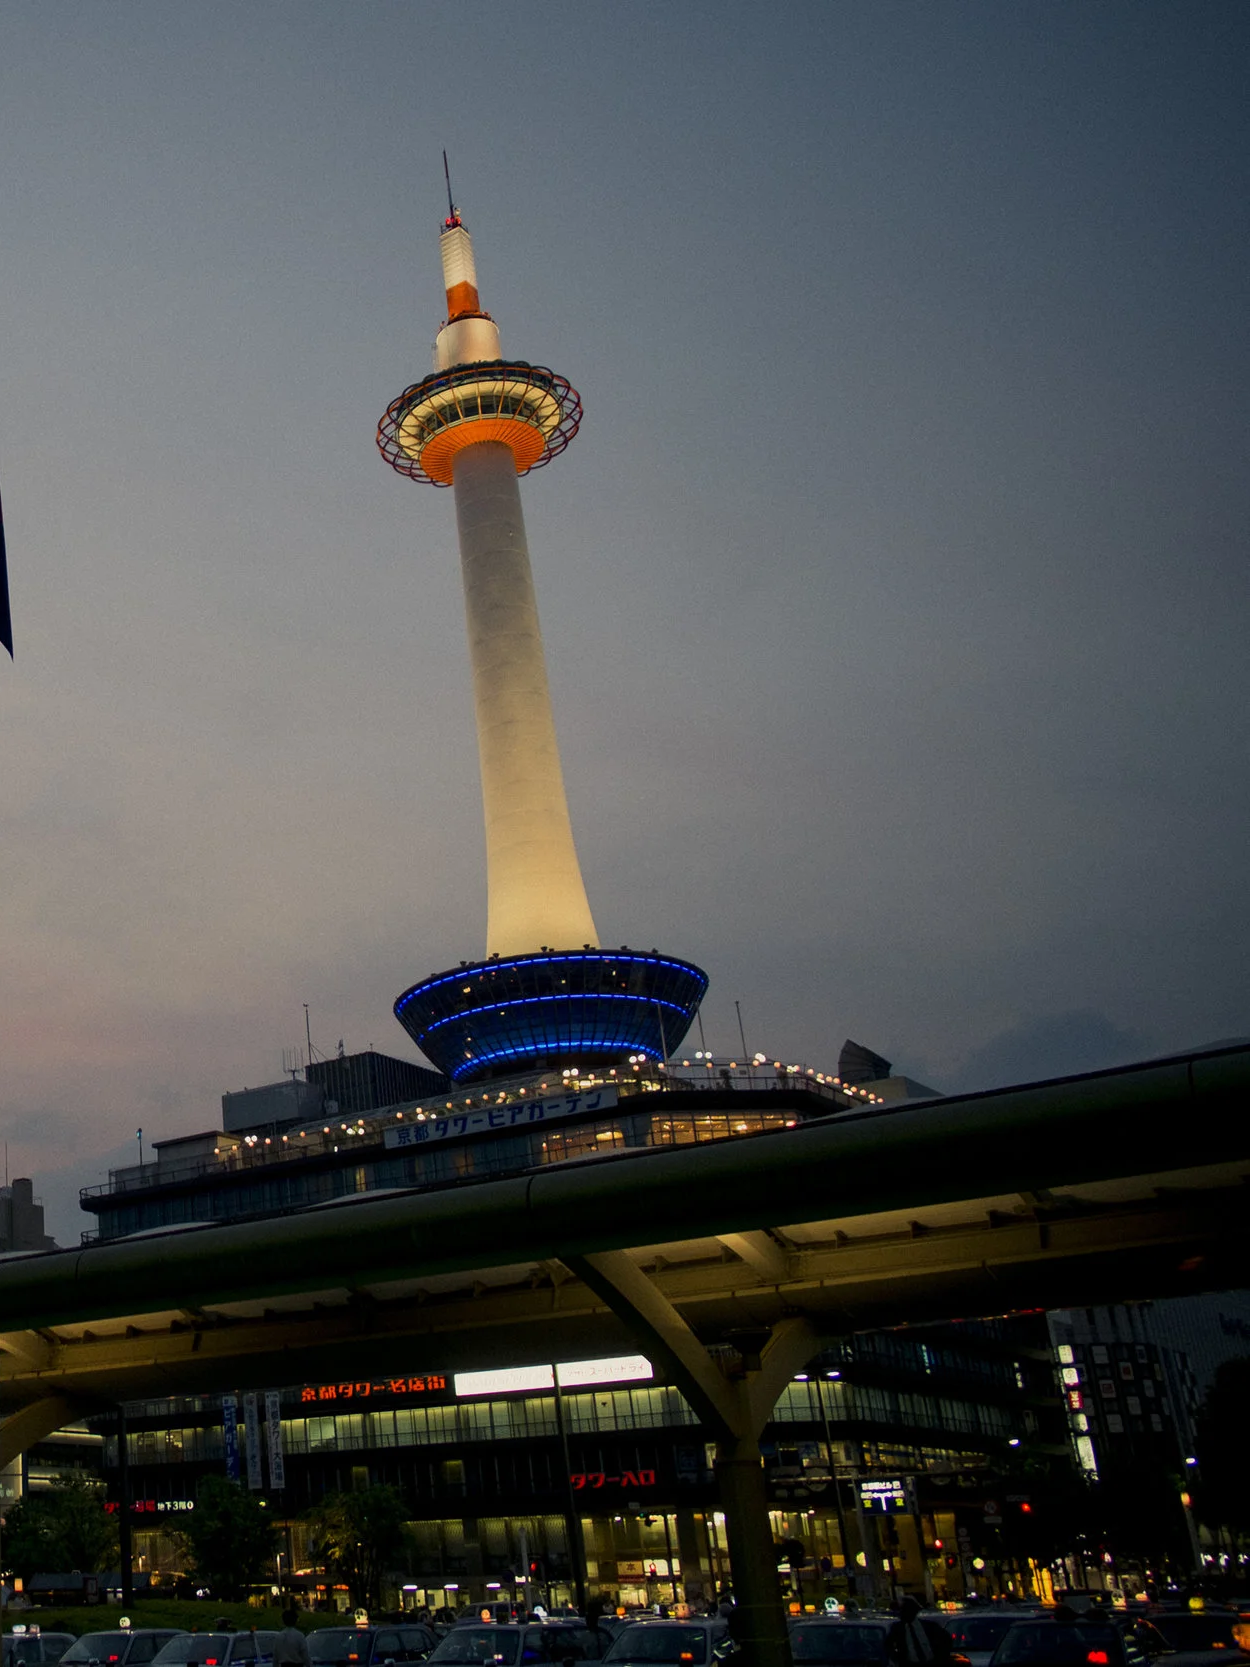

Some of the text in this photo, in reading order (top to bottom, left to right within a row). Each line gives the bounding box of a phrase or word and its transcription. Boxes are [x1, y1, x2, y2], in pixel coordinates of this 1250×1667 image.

[396, 1091, 602, 1145] 京都タワービアガーデン
[301, 1375, 446, 1402] 京都タワー名店街
[570, 1470, 655, 1490] タワー入口
